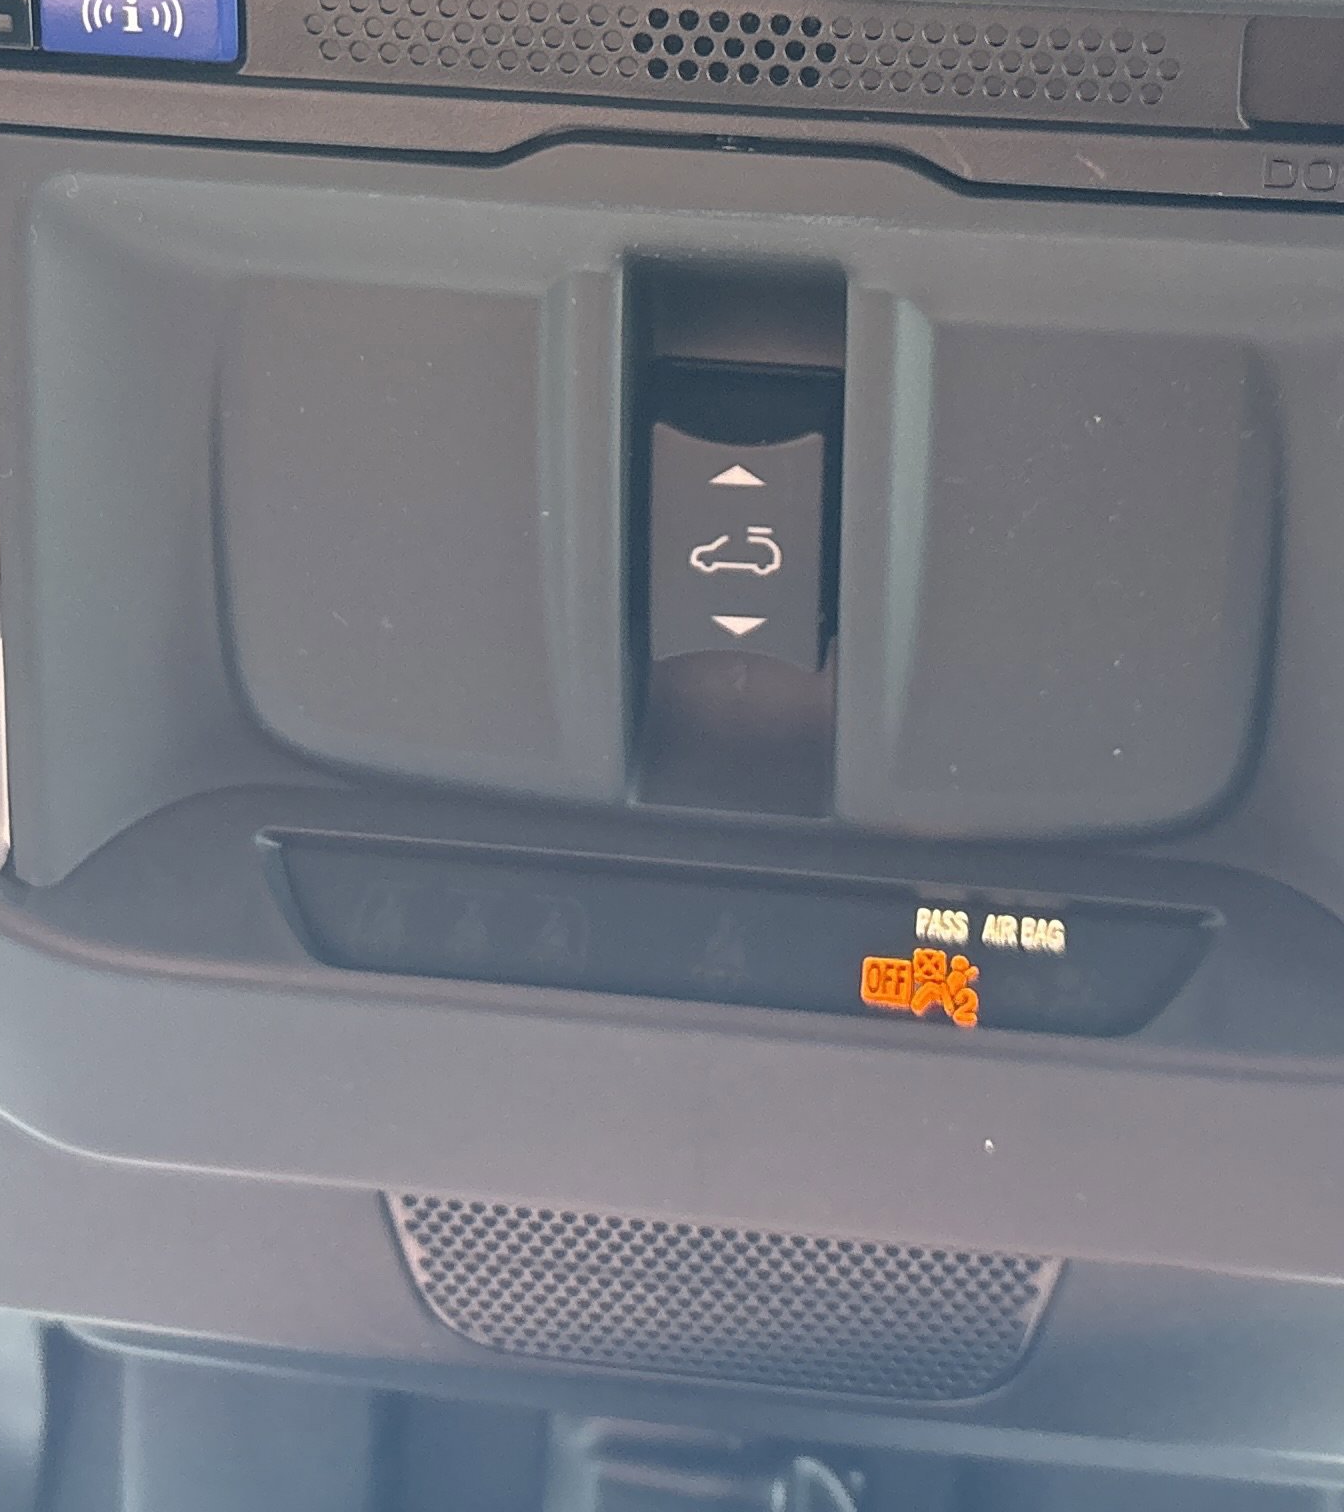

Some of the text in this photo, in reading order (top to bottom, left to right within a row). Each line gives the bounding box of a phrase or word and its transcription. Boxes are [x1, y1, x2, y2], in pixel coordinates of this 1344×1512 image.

[915, 907, 970, 945] PASS
[865, 962, 907, 997] OFF
[952, 987, 980, 1028] 2
